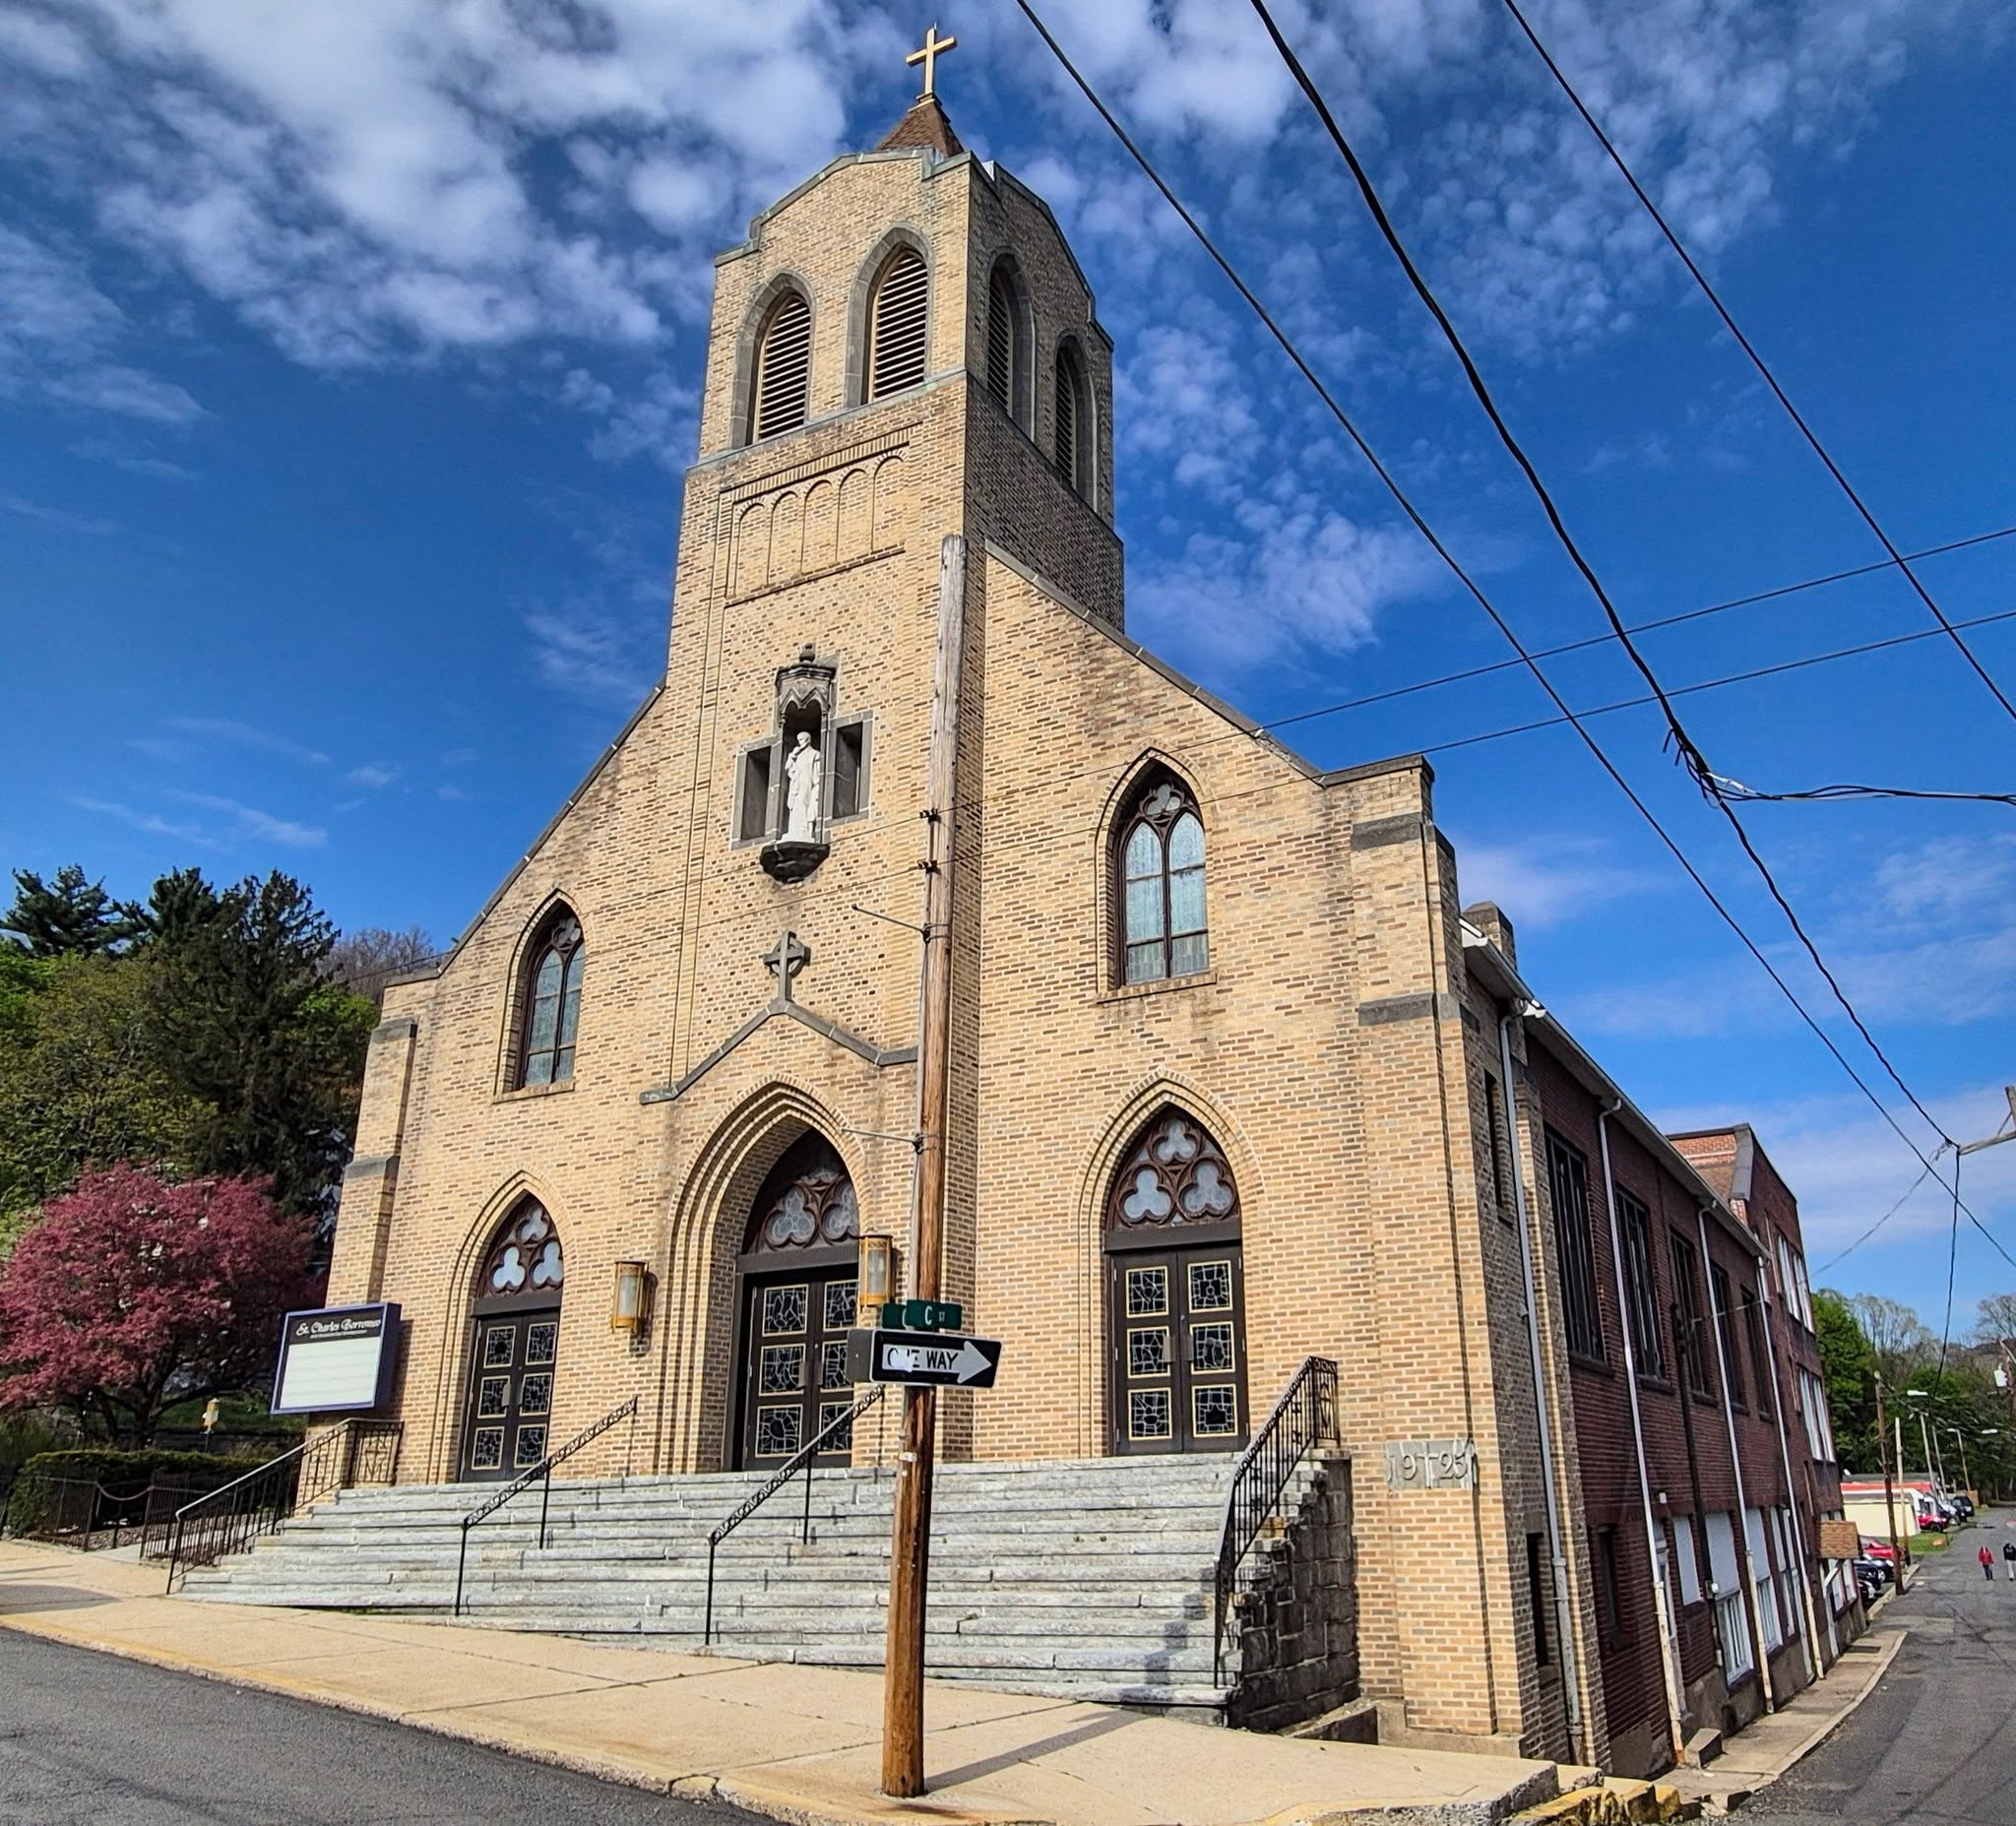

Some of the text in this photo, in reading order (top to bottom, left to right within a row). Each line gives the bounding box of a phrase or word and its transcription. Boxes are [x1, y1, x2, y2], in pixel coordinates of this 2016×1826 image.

[924, 1305, 933, 1325] C
[887, 1348, 959, 1370] OE WAY
